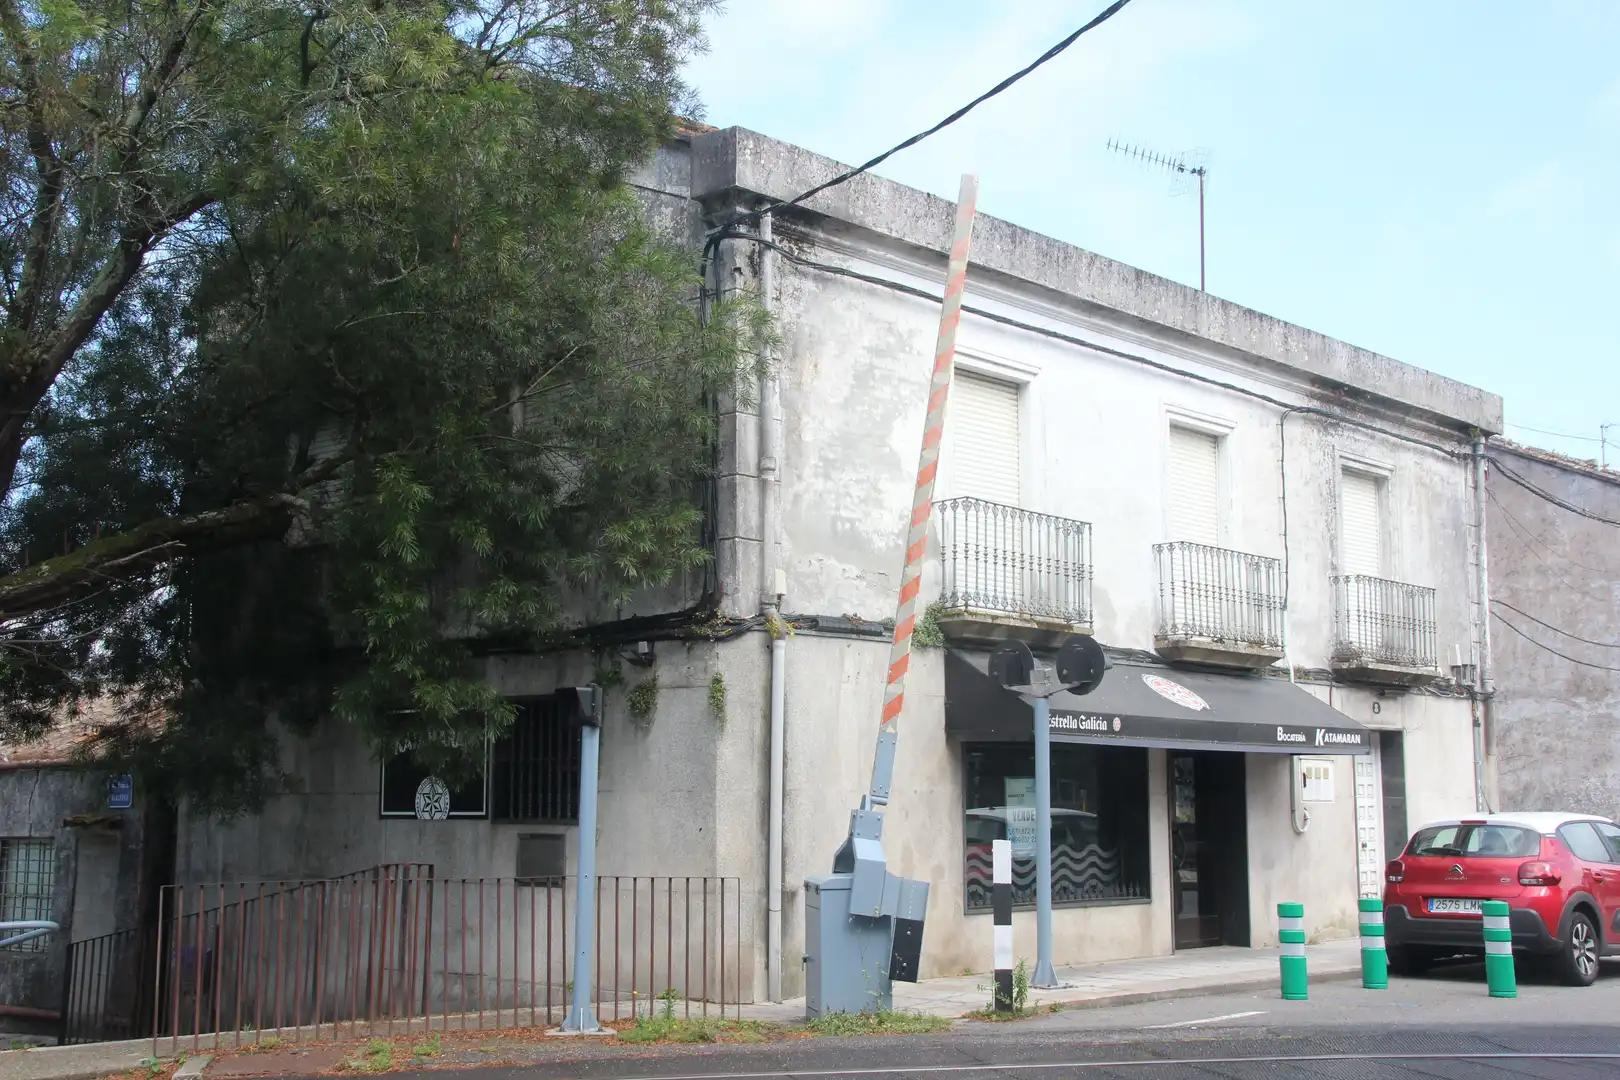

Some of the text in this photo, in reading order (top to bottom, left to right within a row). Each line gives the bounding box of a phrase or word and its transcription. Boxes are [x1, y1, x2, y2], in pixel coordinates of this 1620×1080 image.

[1079, 715, 1107, 730] Galicia
[1315, 728, 1360, 746] KATAMARAN
[1436, 900, 1460, 910] 2575
